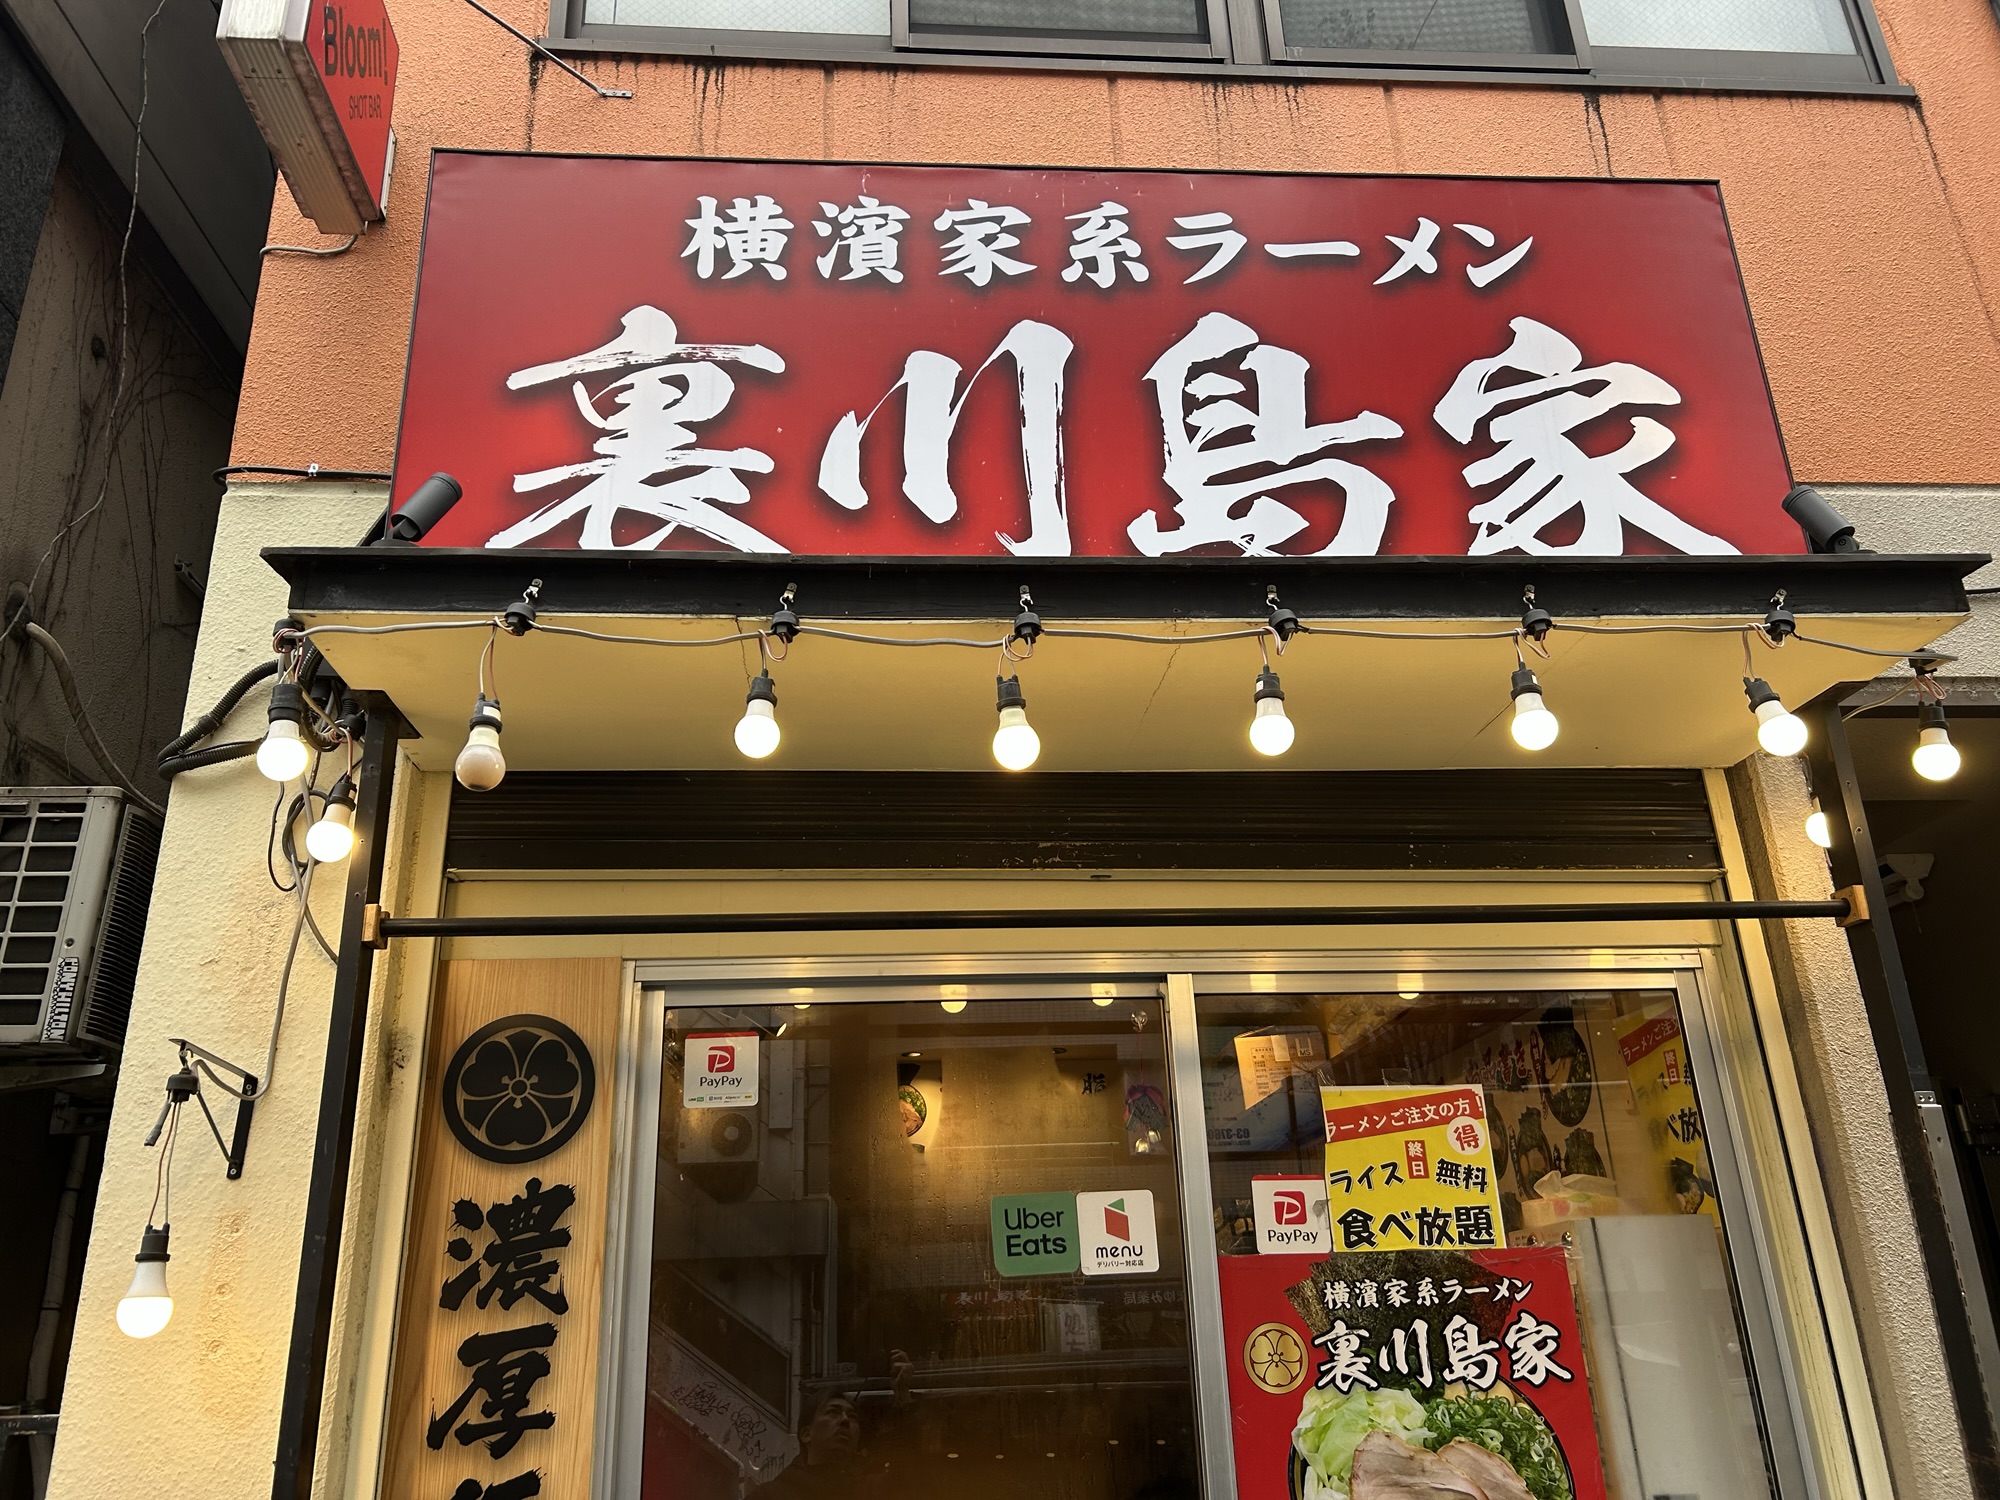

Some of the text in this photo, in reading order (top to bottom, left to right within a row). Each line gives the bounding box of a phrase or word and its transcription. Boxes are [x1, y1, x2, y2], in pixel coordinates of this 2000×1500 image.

[323, 5, 388, 86] Bloom!
[348, 94, 382, 120] SHOT BAR
[681, 194, 1534, 289] 横濱家系ラーメン
[484, 305, 1743, 557] 裏川島家
[700, 1075, 743, 1088] PayPay
[1453, 1123, 1479, 1151] 得
[1407, 1140, 1425, 1177] 終日
[1329, 1161, 1405, 1194] ライス
[1435, 1157, 1488, 1194] 無料
[1004, 1208, 1064, 1231] Uber
[1336, 1205, 1496, 1249] 食べ放題
[1006, 1233, 1067, 1257] Eats
[1096, 1245, 1143, 1258] menu
[1268, 1229, 1318, 1244] PayPay
[1097, 1260, 1144, 1268] デリバリー対応店
[1323, 1277, 1533, 1309] 横濱家系ラーメン
[1314, 1312, 1572, 1392] 裏川島家
